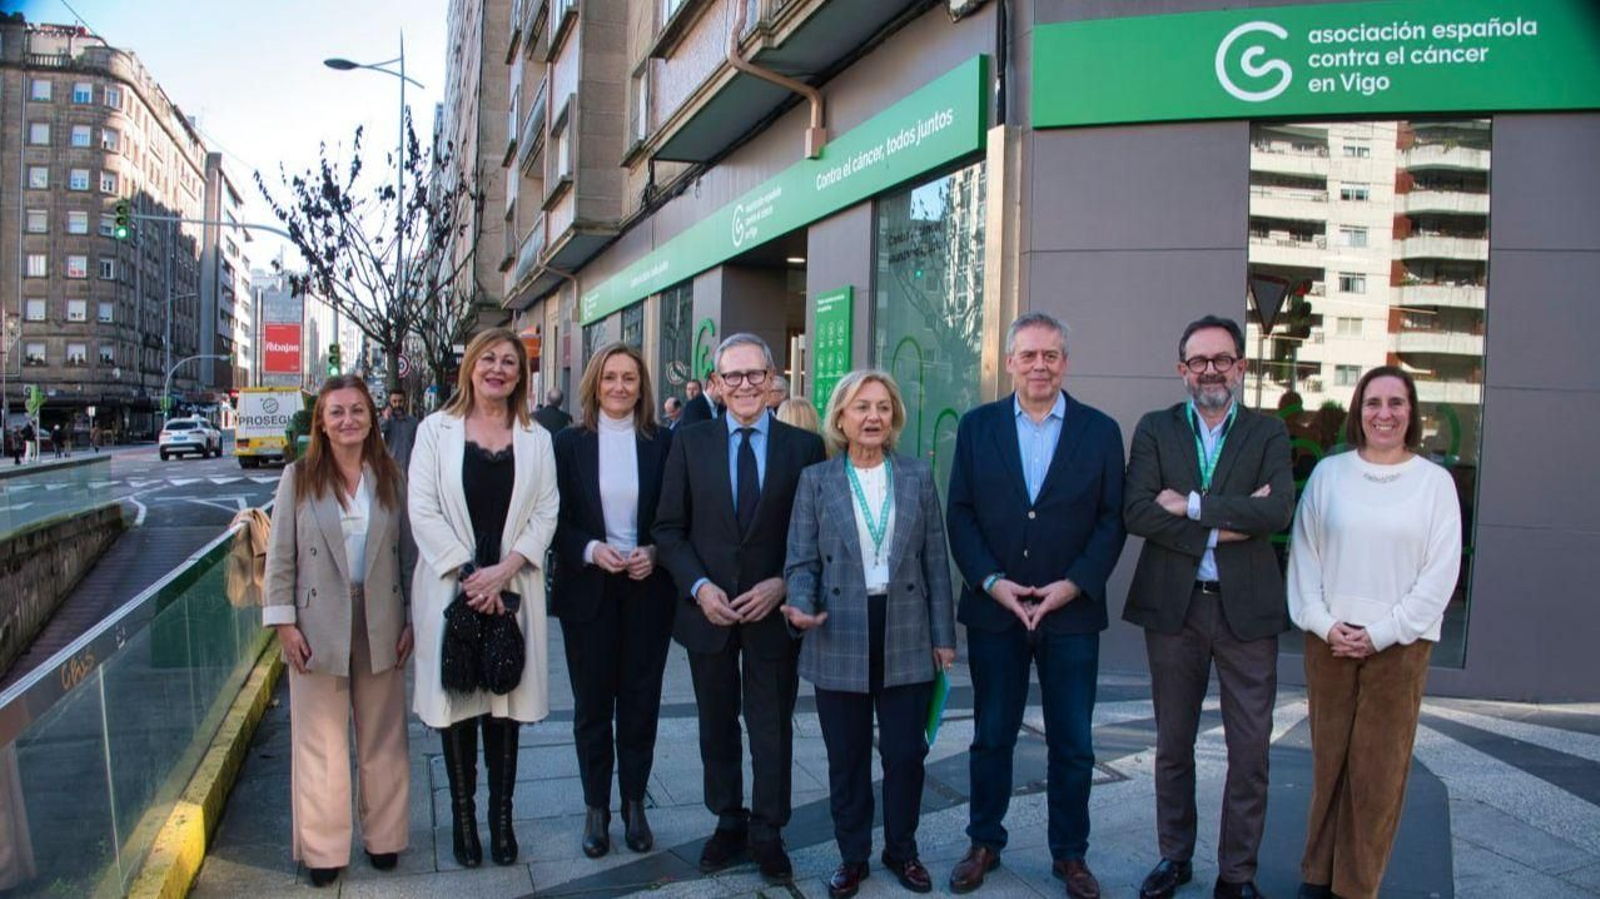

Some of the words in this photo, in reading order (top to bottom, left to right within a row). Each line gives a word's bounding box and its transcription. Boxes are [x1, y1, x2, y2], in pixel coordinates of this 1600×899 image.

[1308, 21, 1426, 44] asociación
[1432, 17, 1537, 42] española
[1308, 48, 1380, 68] contra
[1385, 46, 1405, 66] el
[1410, 44, 1489, 65] cáncer
[1308, 76, 1335, 93] en
[1340, 72, 1391, 96] Vigo
[816, 166, 842, 191] Contra
[843, 156, 851, 177] el
[886, 127, 916, 156] todos
[916, 108, 953, 146] juntos
